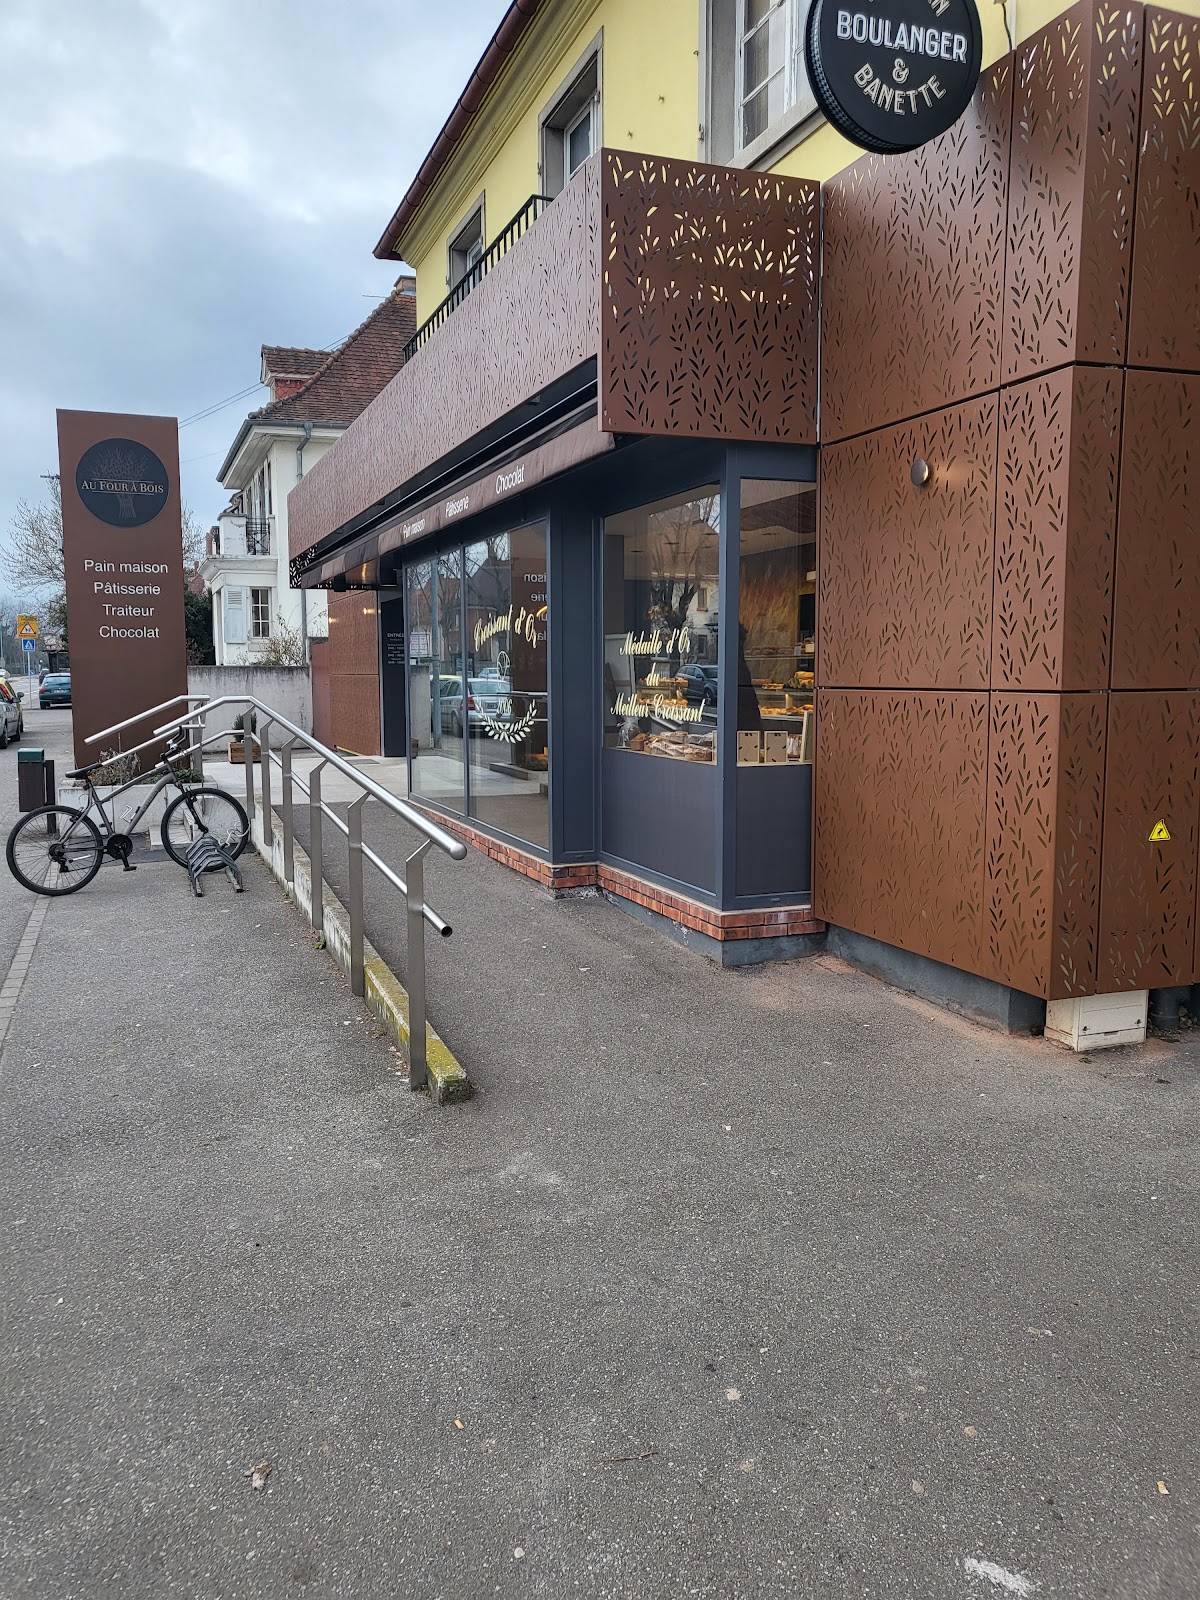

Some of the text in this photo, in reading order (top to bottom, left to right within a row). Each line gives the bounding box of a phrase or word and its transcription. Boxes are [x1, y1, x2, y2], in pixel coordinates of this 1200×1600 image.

[836, 10, 968, 64] BOULANGER
[892, 58, 909, 84] &
[853, 62, 947, 116] BANETTE
[81, 480, 97, 490] AU
[100, 481, 128, 492] FOUR
[140, 483, 164, 493] BOIS
[495, 464, 525, 494] Chocolat
[84, 559, 169, 574] Pain maison
[93, 581, 161, 595] Pâtisserie
[102, 603, 155, 617] Traiteur
[99, 625, 160, 638] Chocolat
[474, 604, 513, 652] Croissant
[619, 626, 691, 656] Médaille d'Or
[646, 662, 660, 686] du
[610, 692, 706, 722] Meilleur Croissant
